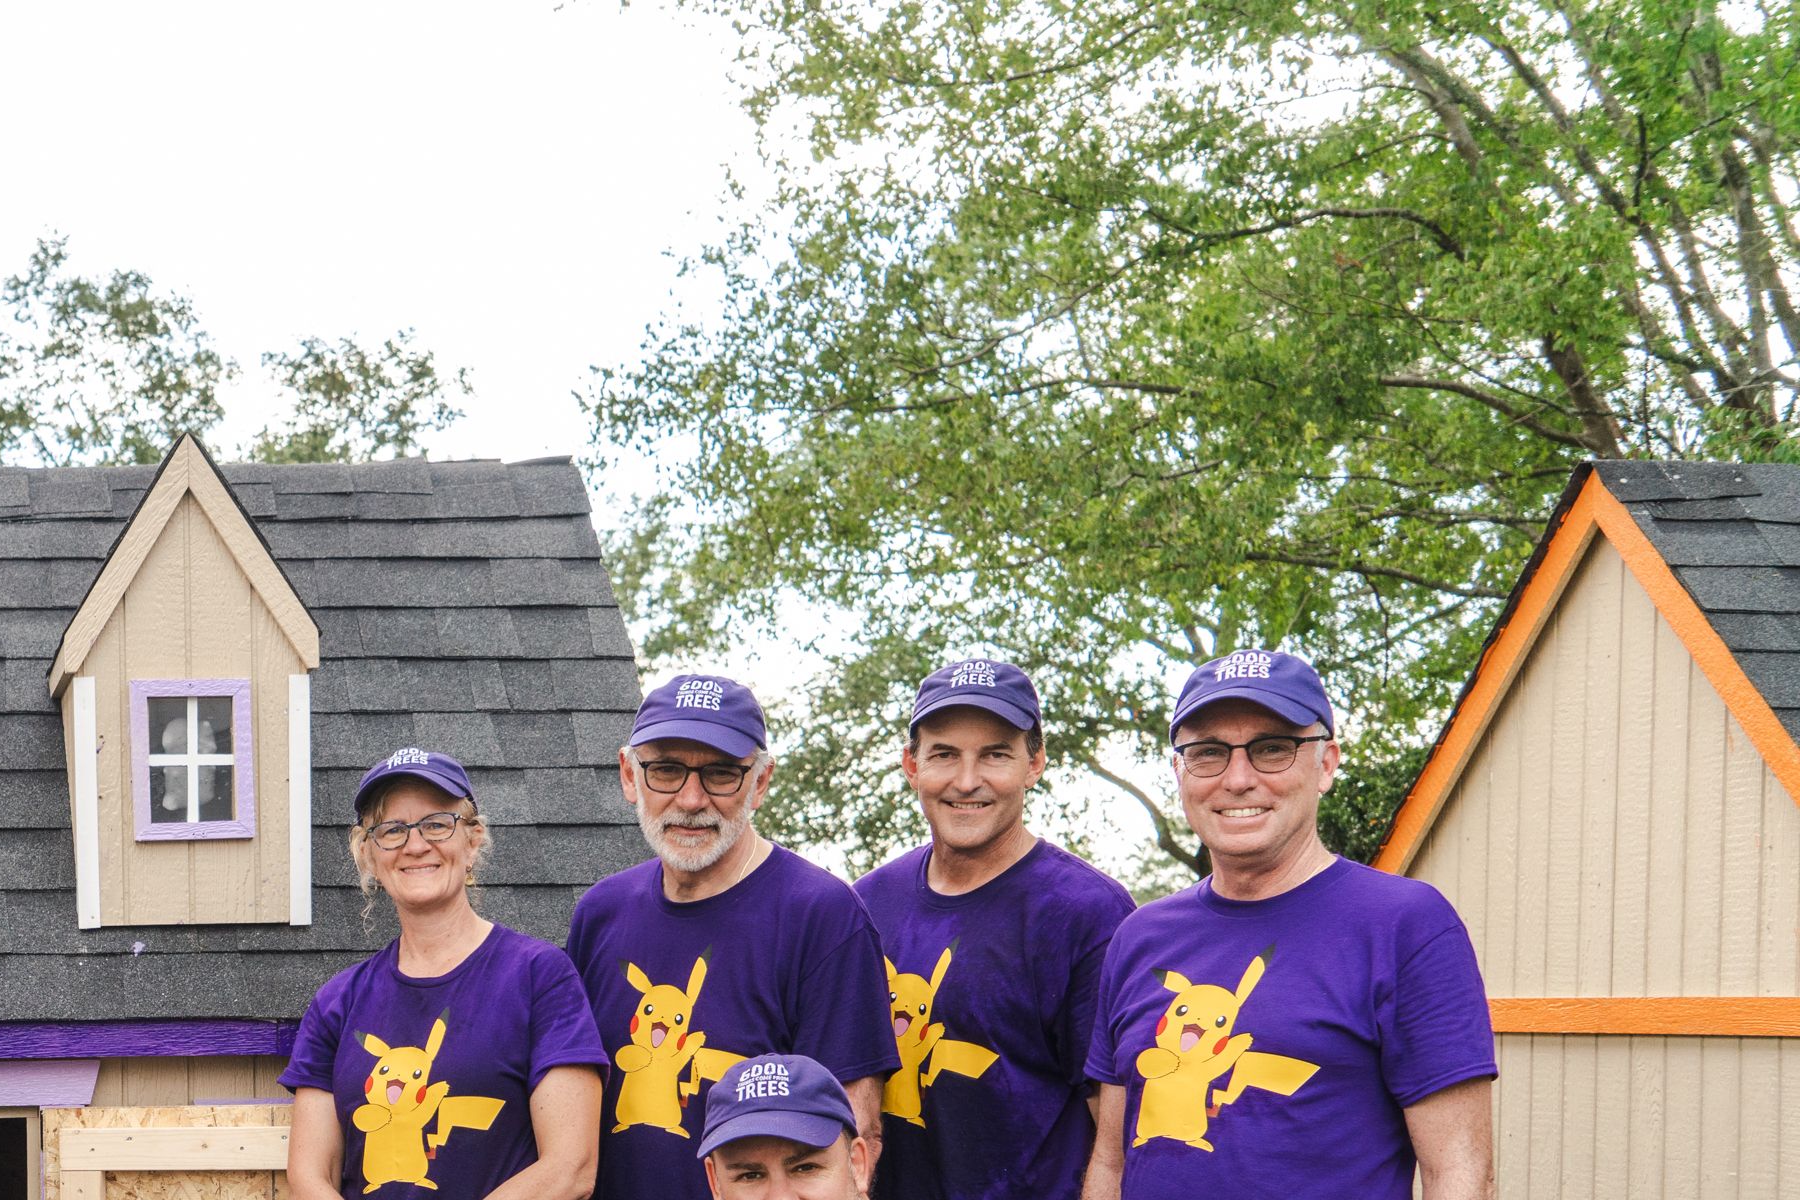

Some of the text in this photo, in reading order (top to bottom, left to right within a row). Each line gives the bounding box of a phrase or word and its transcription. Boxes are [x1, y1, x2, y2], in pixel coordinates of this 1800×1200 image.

[950, 674, 996, 688] TREES
[1215, 664, 1270, 681] TREES
[680, 680, 723, 694] GOOD
[676, 694, 721, 711] TREES
[387, 755, 428, 769] TREES
[740, 1062, 789, 1081] GOOD
[735, 1081, 790, 1102] TREES
